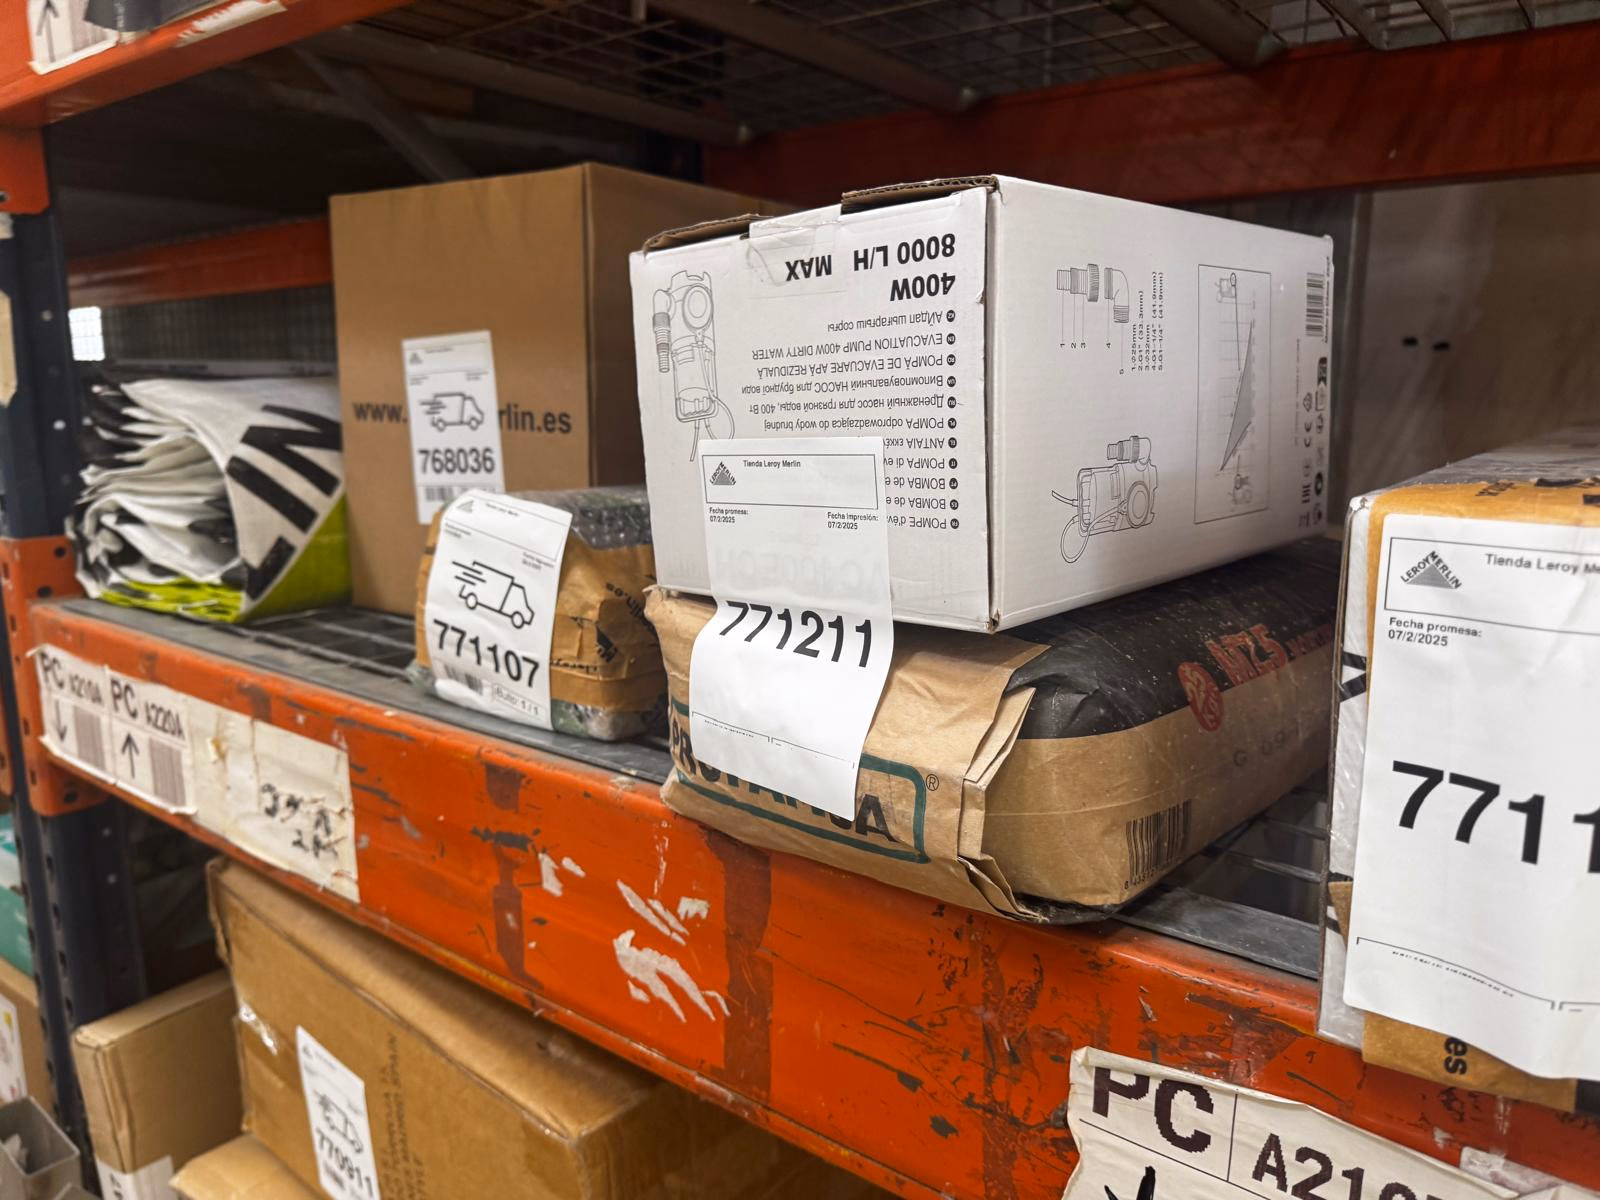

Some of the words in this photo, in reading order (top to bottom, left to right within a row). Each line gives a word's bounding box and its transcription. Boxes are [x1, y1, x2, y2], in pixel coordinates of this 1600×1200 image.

[897, 234, 956, 264] 8000
[854, 245, 888, 271] L/H
[785, 254, 832, 281] MAX
[890, 272, 956, 301] 400W
[843, 340, 872, 353] PUMP
[874, 332, 942, 350] EVACUATION
[752, 348, 784, 360] WATER
[786, 345, 814, 358] DIRTY
[816, 343, 841, 355] 400W
[830, 358, 884, 373] EVACUARE
[887, 358, 902, 370] DE
[796, 381, 812, 392] для
[814, 381, 848, 393] НАСОС
[803, 398, 836, 412] грязной
[839, 398, 856, 409] для
[858, 398, 884, 408] насос
[887, 394, 944, 410] Дренажный
[761, 404, 776, 414] 400
[764, 419, 793, 432] brudnej
[796, 418, 817, 431] wody
[819, 420, 830, 430] do
[832, 416, 903, 430] odprowadzająca
[906, 417, 944, 429] POMPA
[418, 448, 494, 474] 768036
[764, 460, 780, 468] Leroy
[897, 458, 904, 468] di
[906, 458, 945, 469] POMPA
[720, 461, 736, 485] MERLIN
[893, 477, 905, 488] de
[907, 477, 945, 490] BOMBA
[894, 497, 905, 507] de
[908, 498, 946, 509] BOMBA
[828, 521, 858, 529] 07/2/2025
[909, 517, 946, 529] POMPE
[1400, 555, 1430, 583] LEROY
[1429, 550, 1462, 589] MERLIN
[1486, 554, 1532, 568] Tienda
[1536, 558, 1578, 576] Leroy
[1390, 617, 1424, 629] Fecha
[1427, 623, 1482, 637] promesa:
[719, 600, 872, 668] 771211
[1388, 629, 1448, 647] 07/2/2025
[433, 619, 539, 688] 771107
[40, 652, 64, 689] PC
[110, 679, 138, 719] PC
[1444, 1037, 1468, 1075] es
[1092, 1066, 1214, 1154] PC
